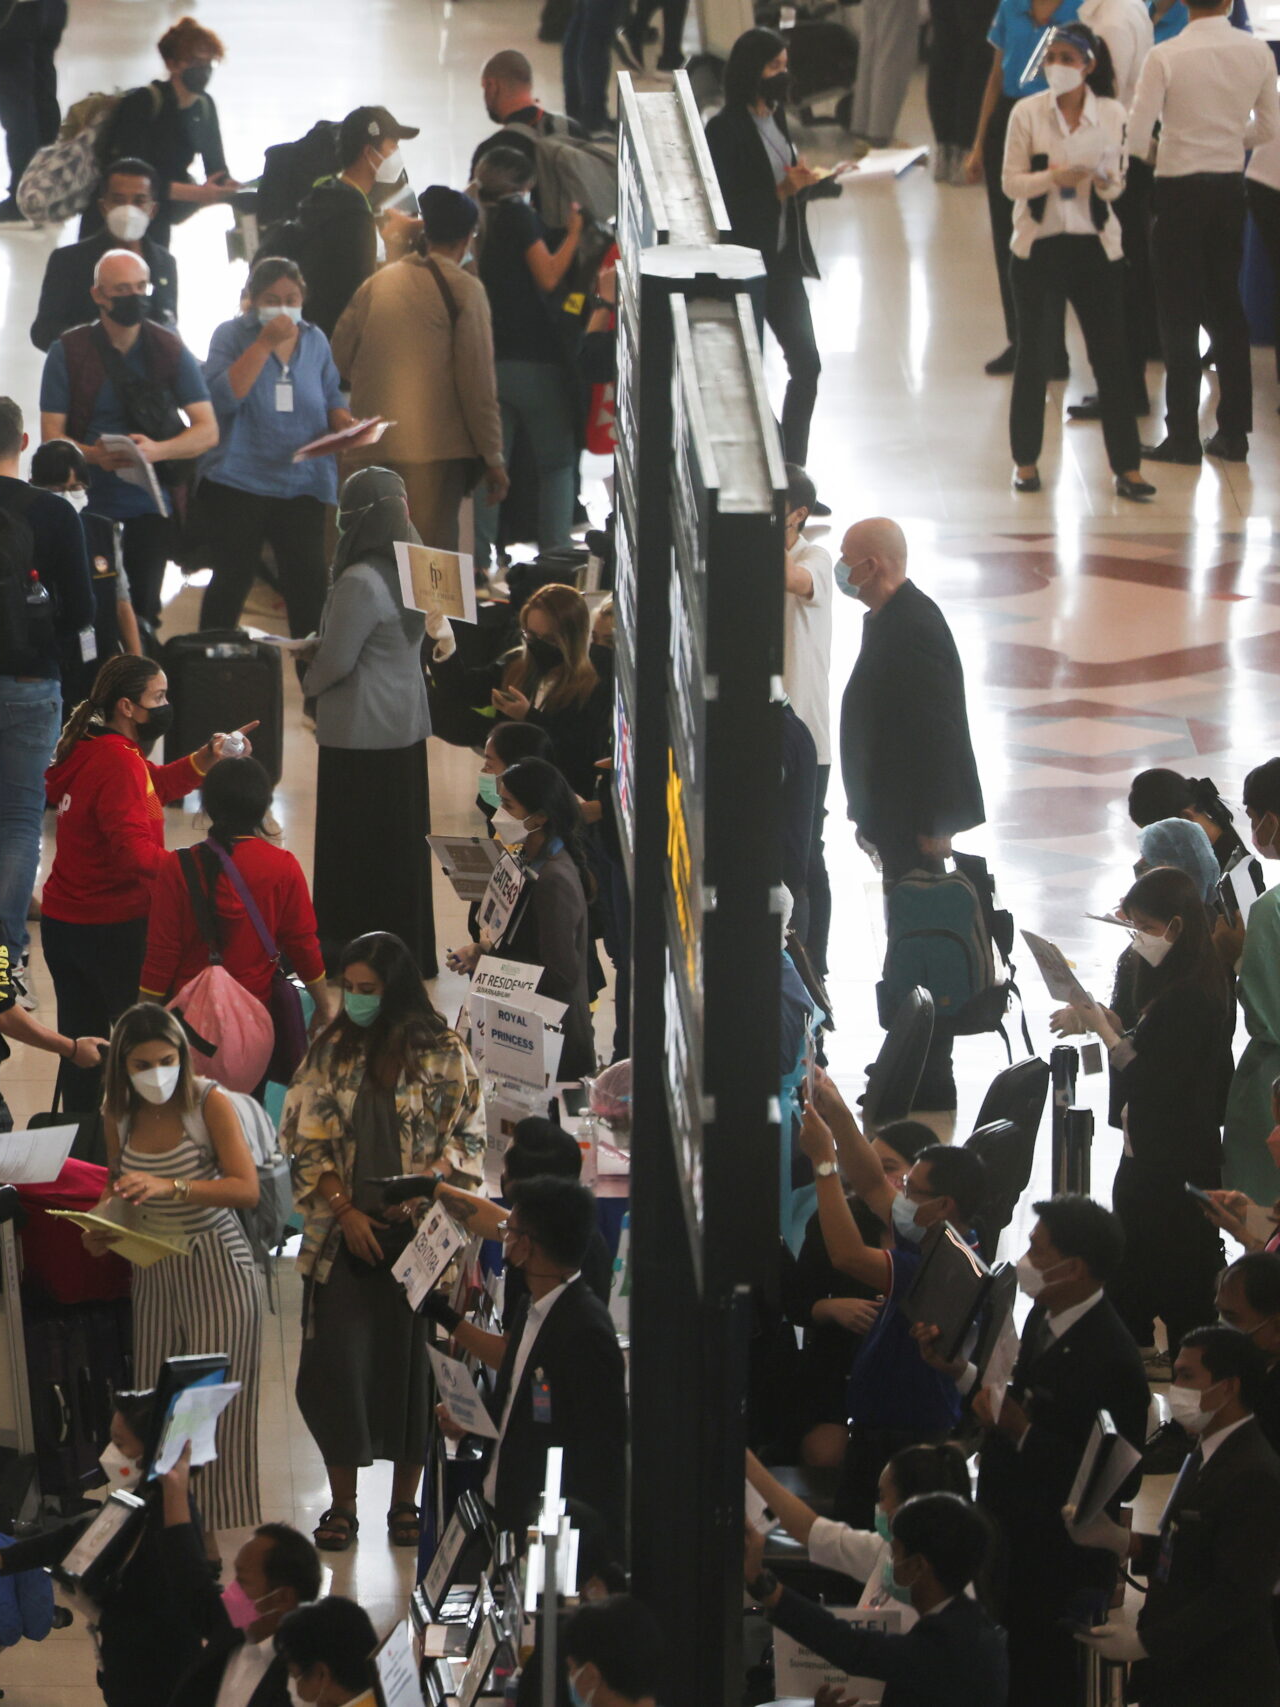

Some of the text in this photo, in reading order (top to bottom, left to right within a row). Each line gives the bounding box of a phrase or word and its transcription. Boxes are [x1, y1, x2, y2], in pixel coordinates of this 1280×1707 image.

[474, 972, 488, 985] AT
[498, 1009, 528, 1028] ROYAL
[491, 1028, 535, 1051] PRINCESS
